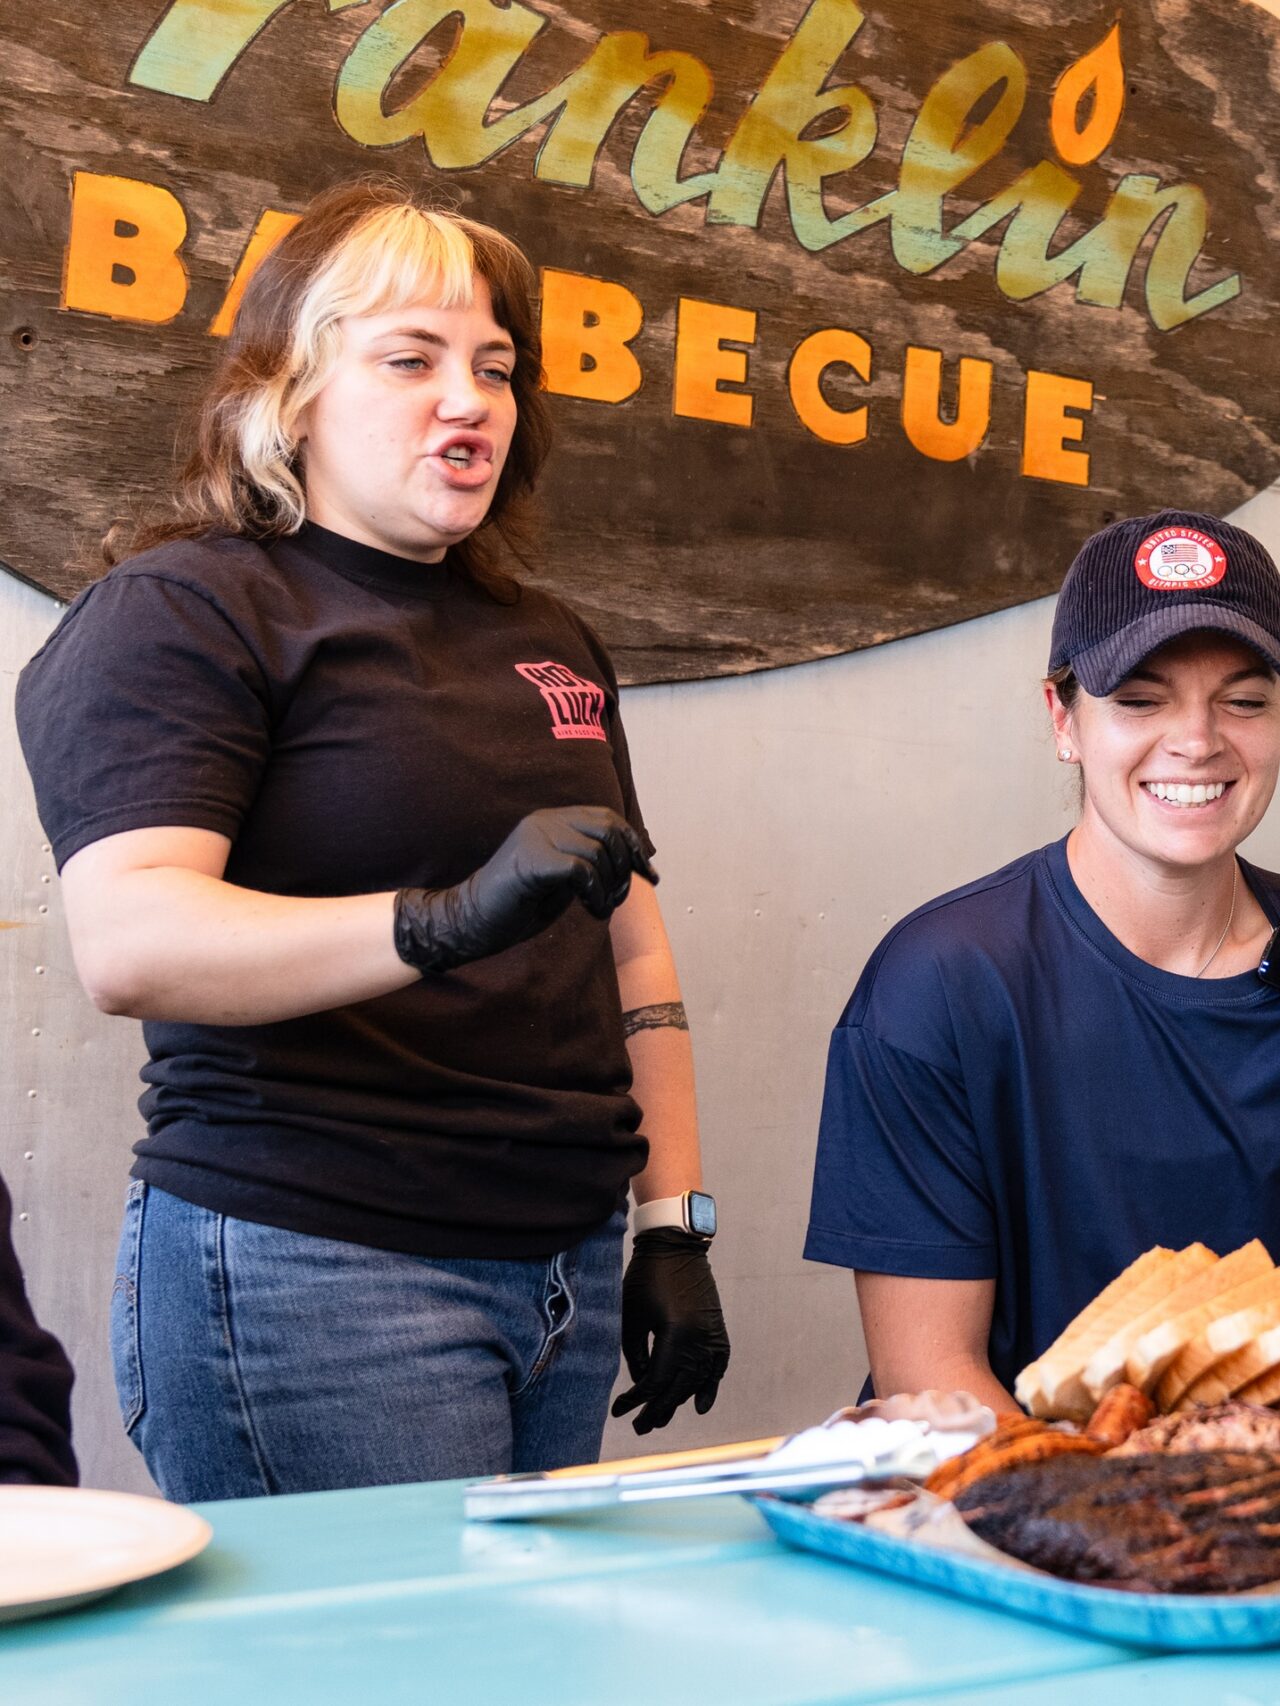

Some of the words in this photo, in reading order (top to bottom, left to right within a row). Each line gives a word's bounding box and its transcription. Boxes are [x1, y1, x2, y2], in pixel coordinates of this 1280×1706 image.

[60, 172, 1094, 486] BBECUE
[1144, 530, 1177, 549] UNITED
[1181, 530, 1214, 548] STATES
[1148, 578, 1189, 588] OLYMPIC
[1194, 575, 1216, 587] TEAM
[524, 665, 588, 687] HOT
[548, 691, 601, 727] LUCK
